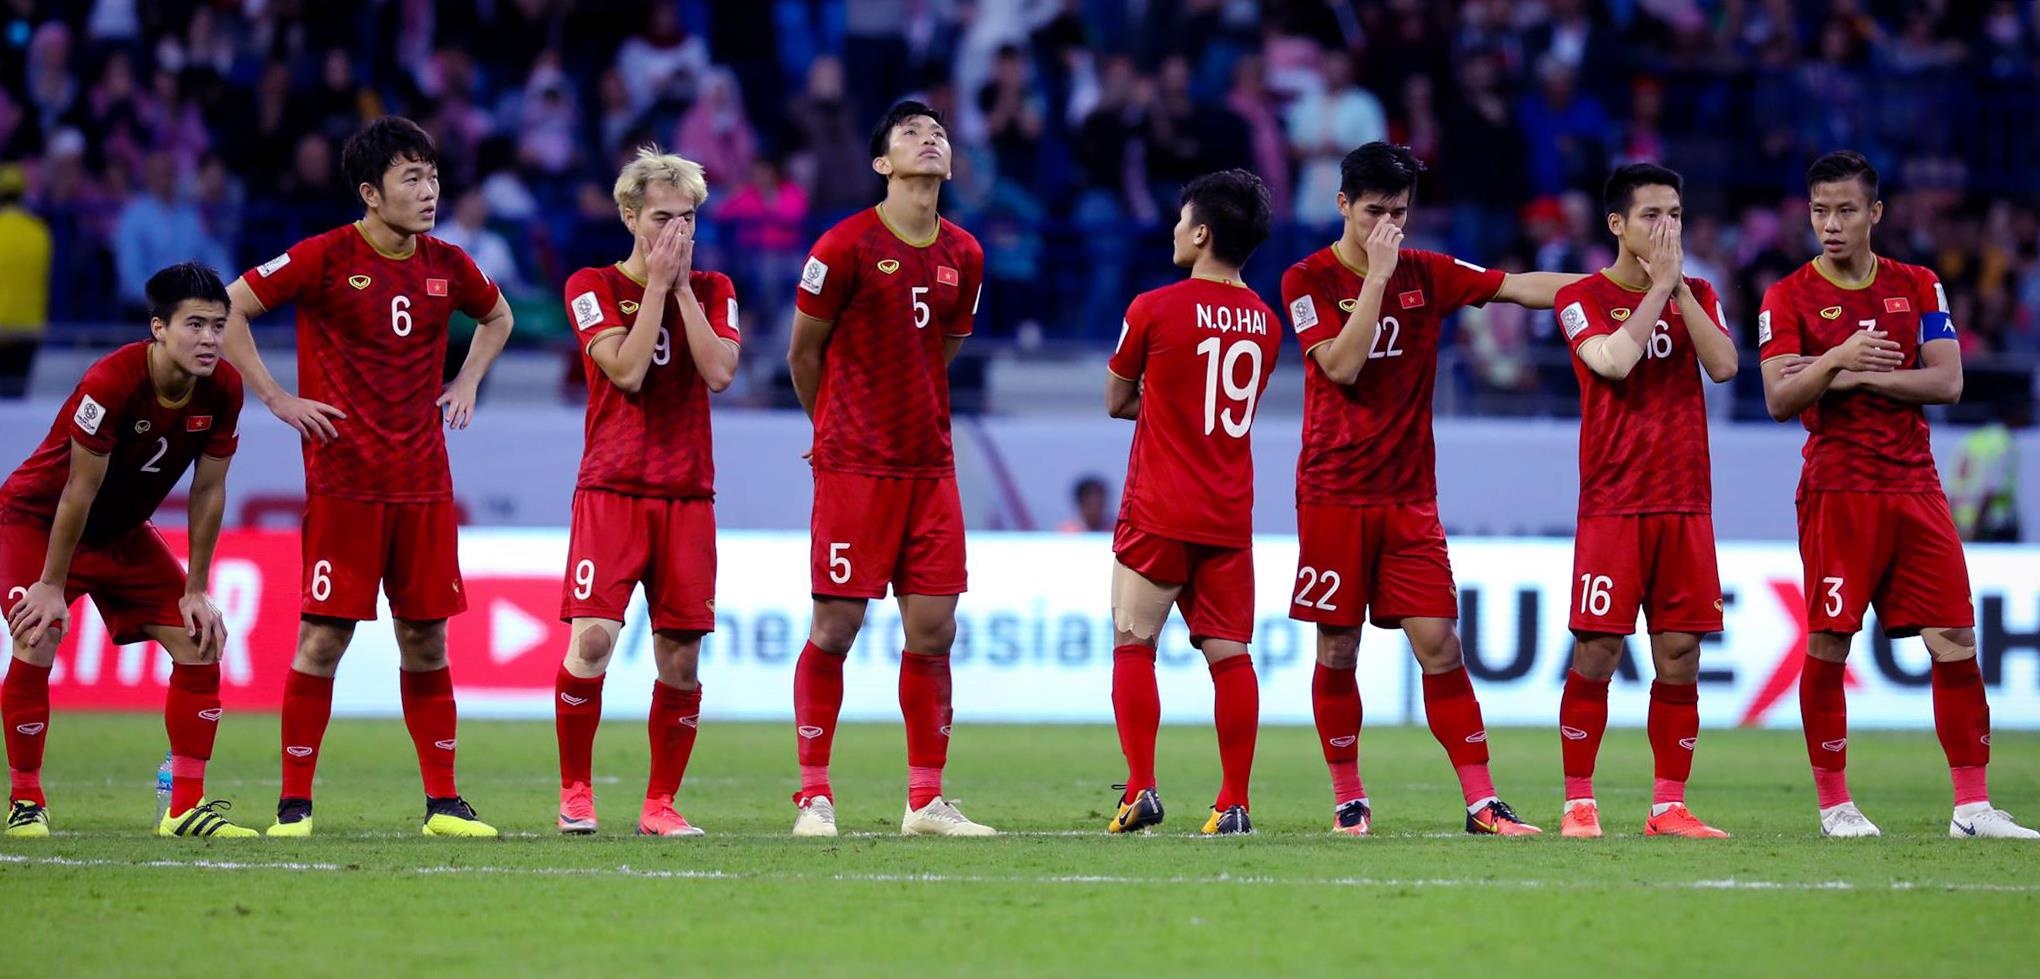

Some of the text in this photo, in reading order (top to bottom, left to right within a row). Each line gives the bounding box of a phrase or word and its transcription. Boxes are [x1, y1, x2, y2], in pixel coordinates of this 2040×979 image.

[391, 295, 412, 337] 6
[912, 287, 930, 329] 5
[1196, 303, 1267, 336] N.Q.HAI
[652, 326, 671, 366] 9
[1368, 316, 1403, 359] 22
[1196, 337, 1262, 438] 19
[140, 436, 168, 473] 2
[311, 560, 333, 602] 6
[574, 559, 595, 600] 9
[829, 542, 852, 584] 5
[1295, 566, 1341, 611] 22
[1580, 573, 1614, 617] 16
[1823, 576, 1844, 618] 3
